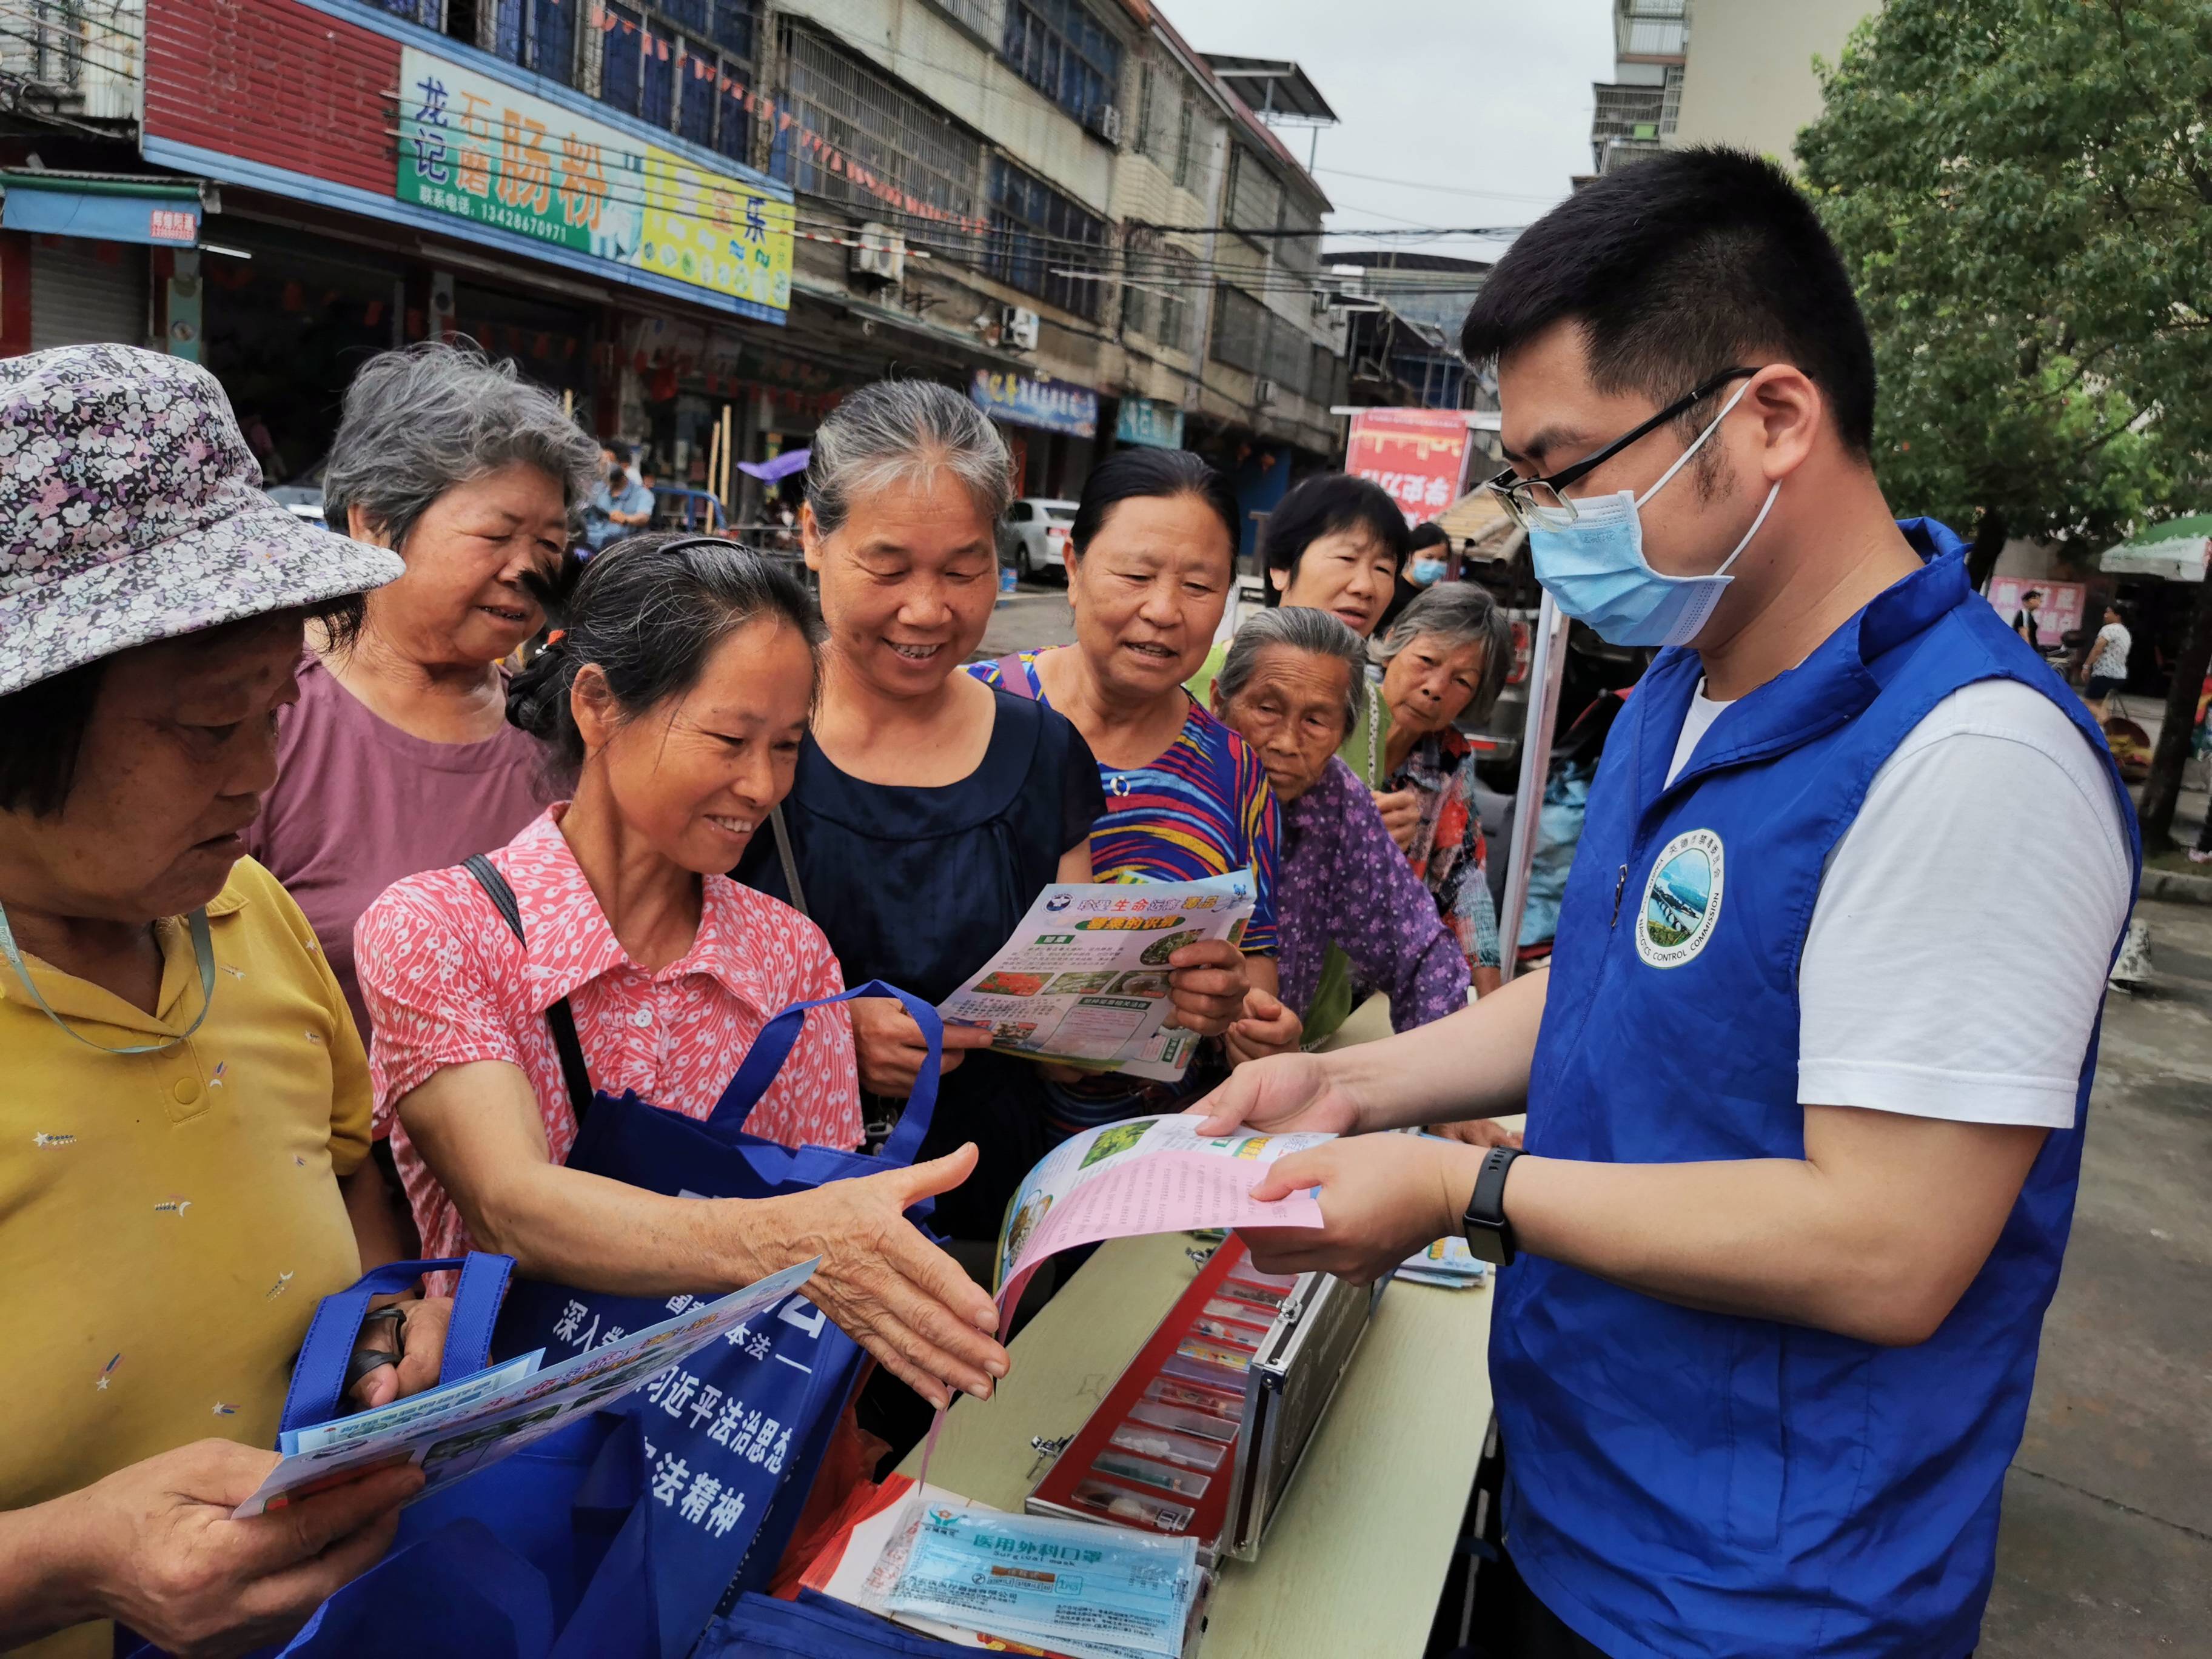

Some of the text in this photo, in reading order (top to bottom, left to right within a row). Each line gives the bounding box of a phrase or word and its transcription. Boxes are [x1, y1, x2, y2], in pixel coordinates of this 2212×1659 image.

[414, 76, 449, 184] 龙记
[498, 108, 607, 231] 肠粉
[1652, 949, 1687, 962] CONTROL
[1690, 891, 1720, 951] COMMISSION
[973, 1534, 1103, 1564] 医用外科口罩
